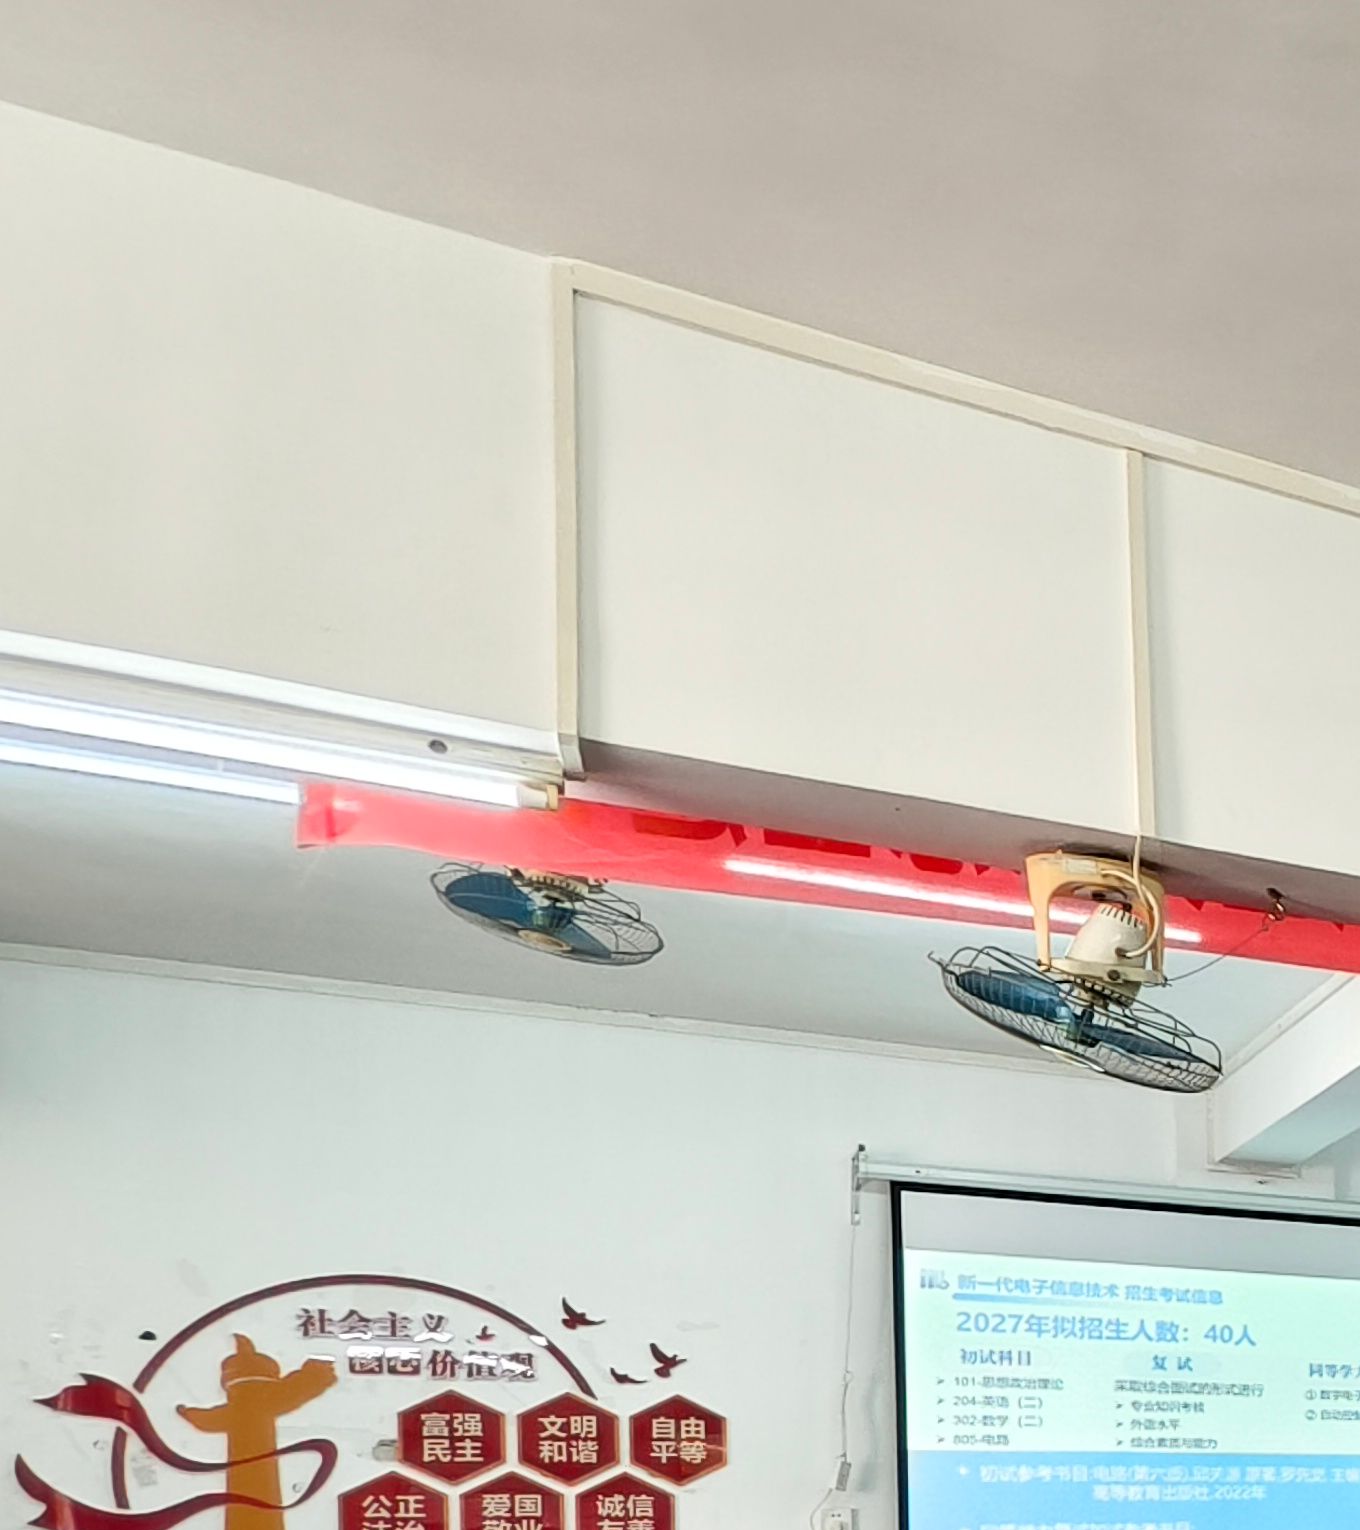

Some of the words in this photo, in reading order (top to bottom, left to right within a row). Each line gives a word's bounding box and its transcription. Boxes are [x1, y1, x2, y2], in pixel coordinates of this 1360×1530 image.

[297, 1308, 455, 1342] 社会主义
[960, 1348, 1032, 1367] 初试科目
[420, 1412, 484, 1437] 富强
[538, 1415, 598, 1438] 文明
[651, 1416, 706, 1440] 自由
[422, 1438, 485, 1463] 民主
[539, 1440, 600, 1465] 和谐
[650, 1441, 708, 1465] 平等
[362, 1494, 426, 1519] 公正
[481, 1494, 543, 1518] 爱国
[596, 1494, 654, 1517] 诚信
